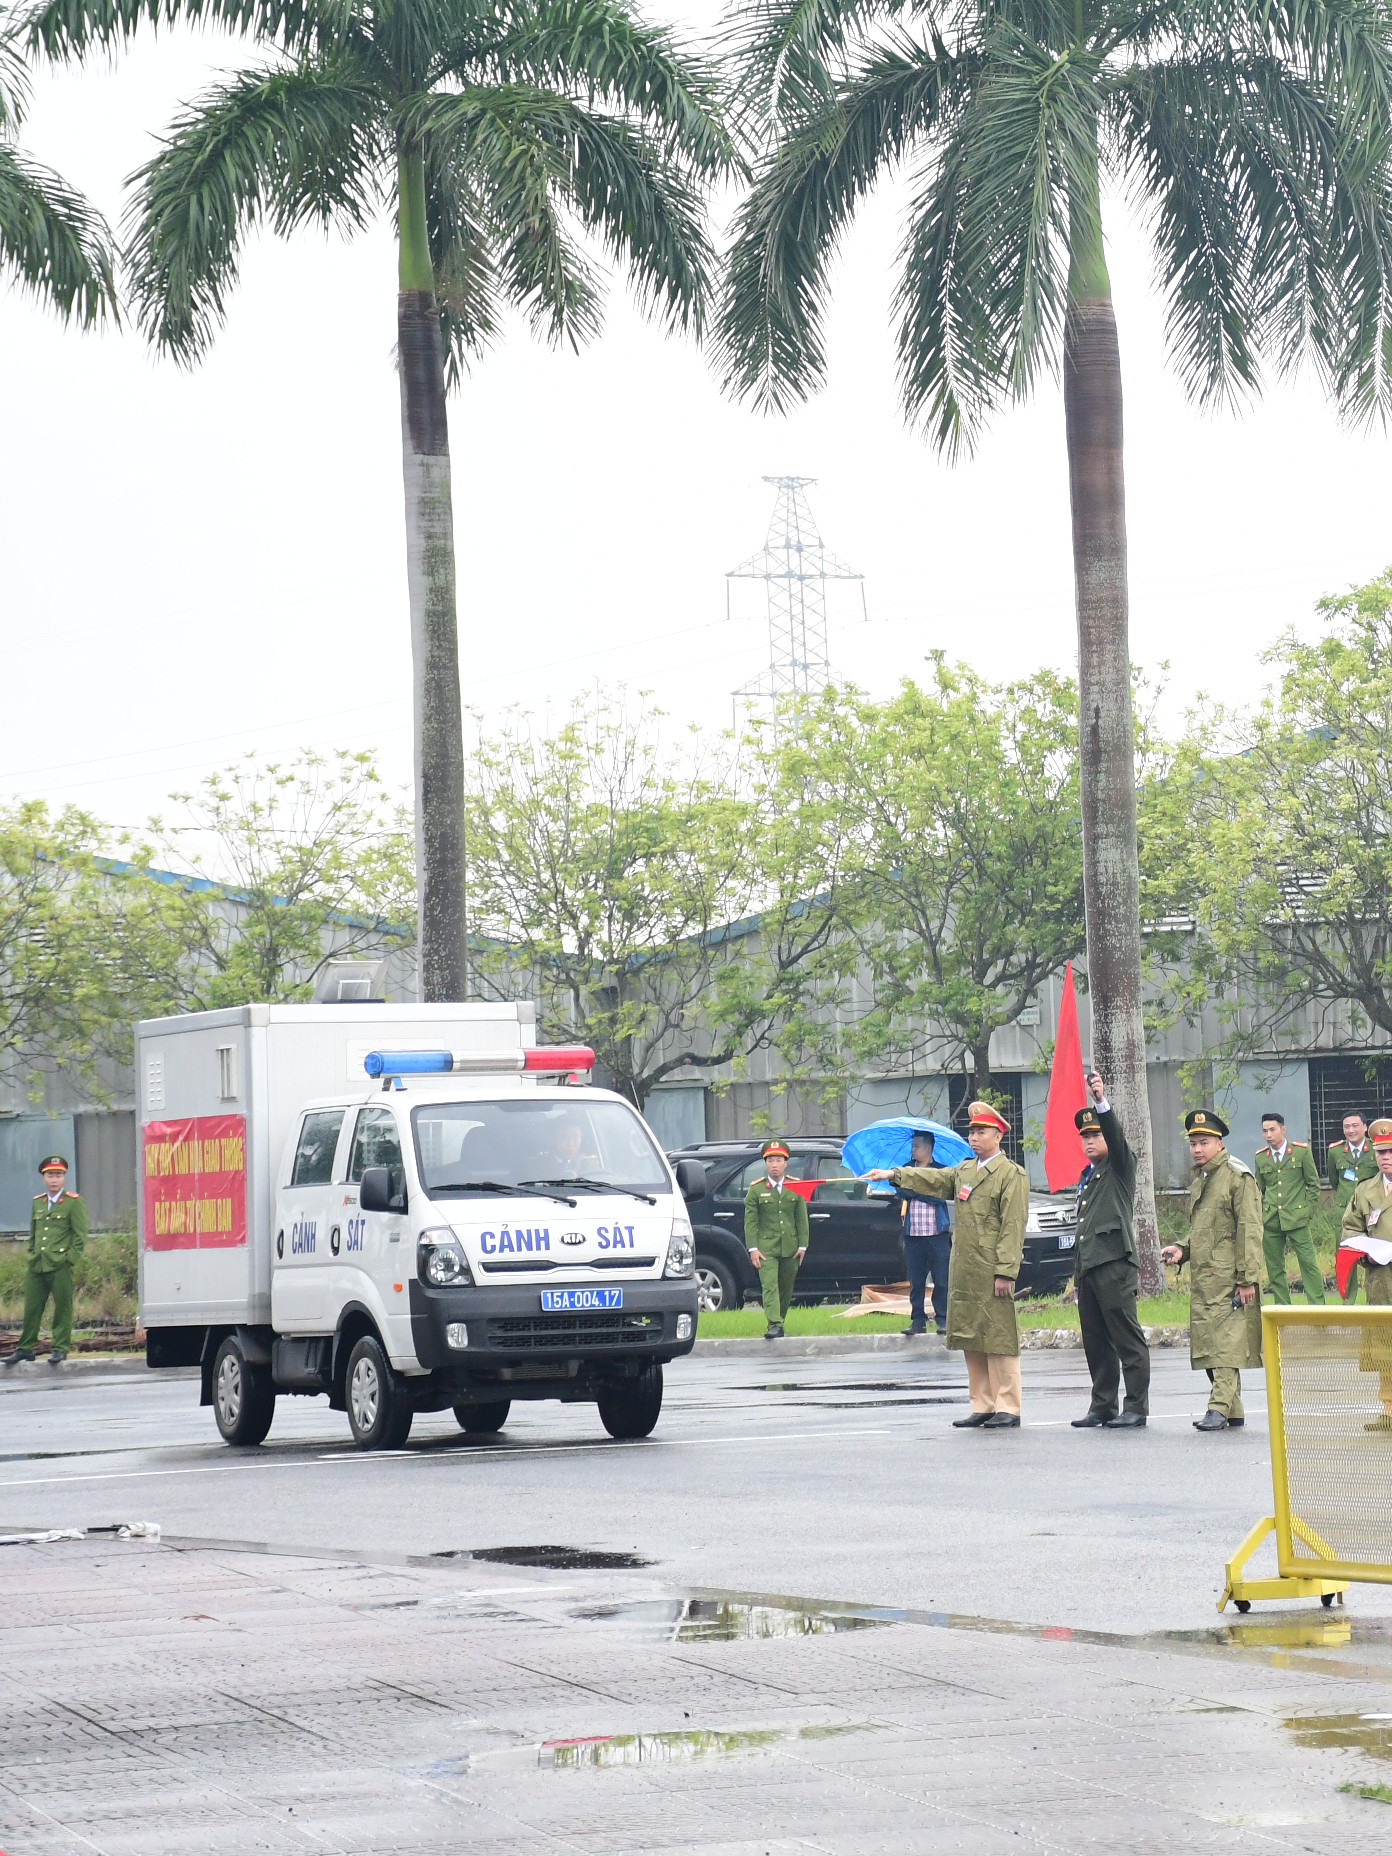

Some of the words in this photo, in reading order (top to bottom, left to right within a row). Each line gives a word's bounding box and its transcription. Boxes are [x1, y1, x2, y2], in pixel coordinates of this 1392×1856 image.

[204, 1139, 219, 1173] GIAO
[292, 1212, 316, 1254] CẢNH
[347, 1213, 365, 1251] SÁT
[481, 1224, 550, 1254] CẢNH
[597, 1222, 634, 1249] SÁT
[561, 1233, 584, 1244] KIA
[546, 1290, 619, 1308] 15A-004.17
